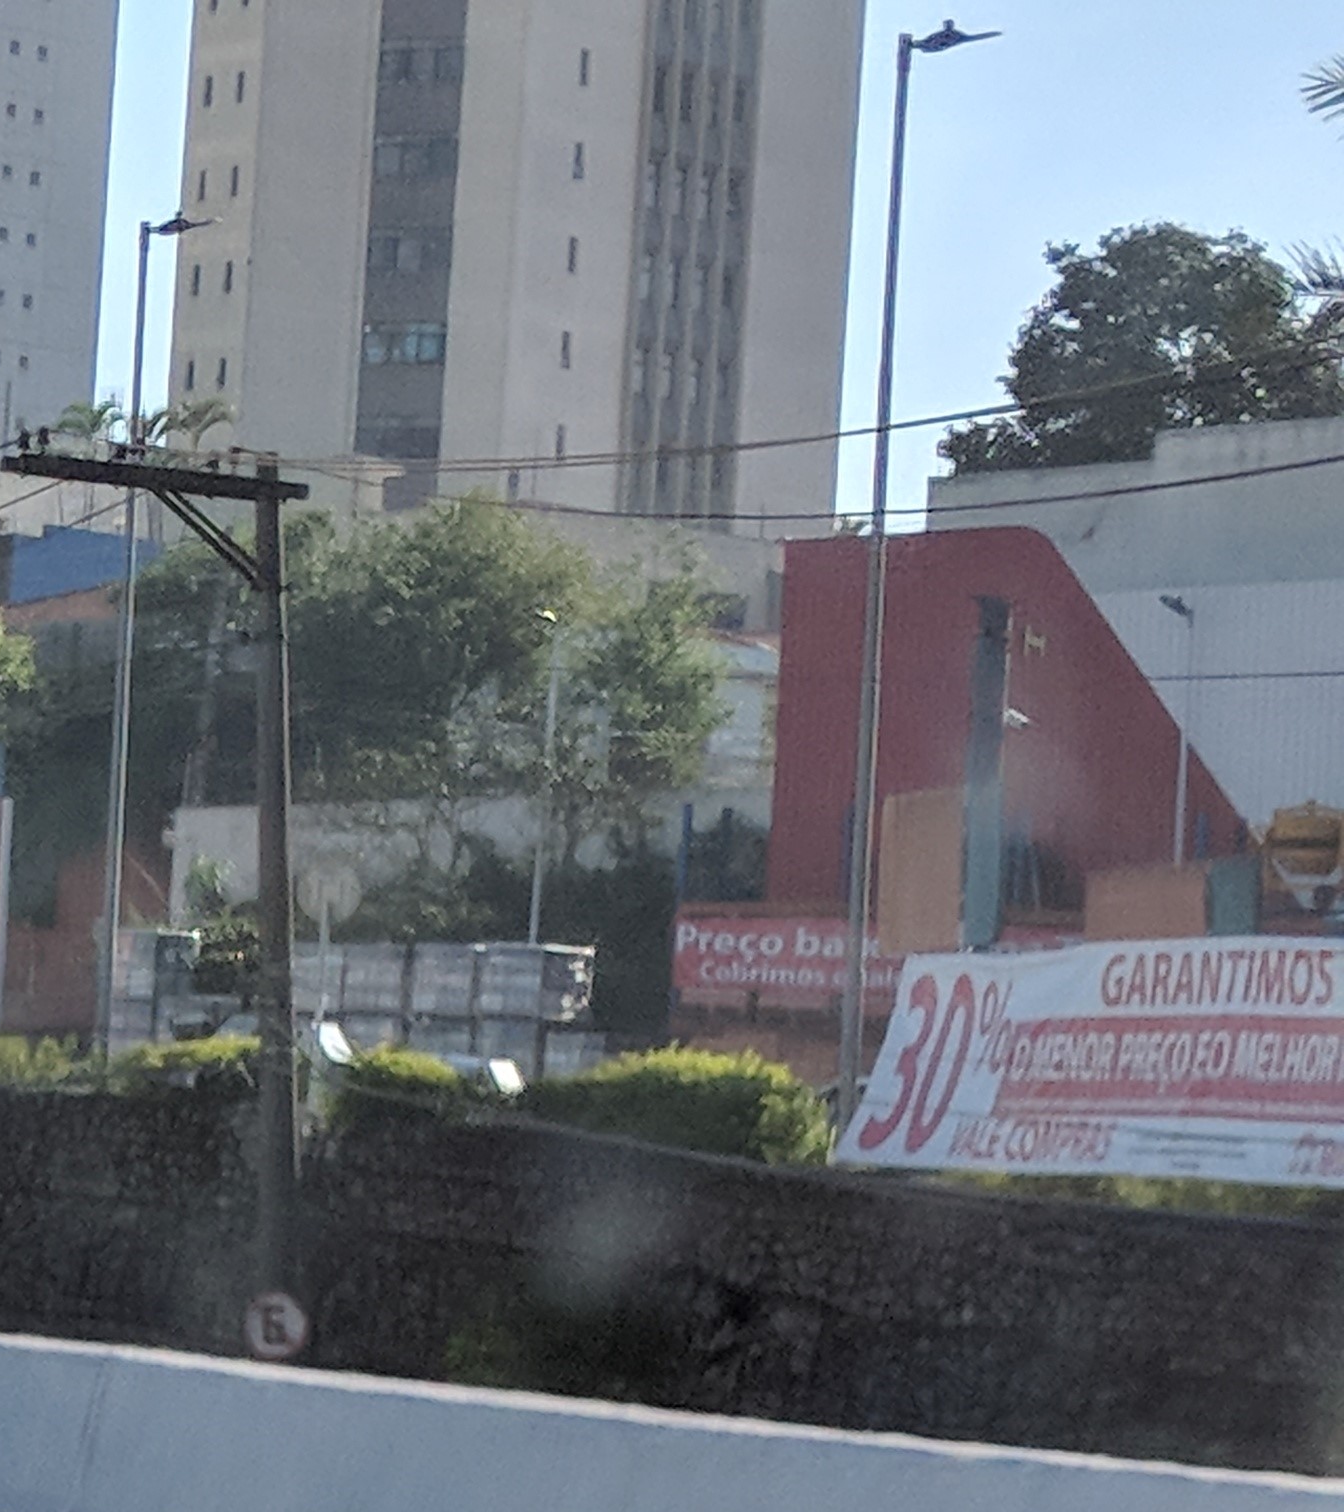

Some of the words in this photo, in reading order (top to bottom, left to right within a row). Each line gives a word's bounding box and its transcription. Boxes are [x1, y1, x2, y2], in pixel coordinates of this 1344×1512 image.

[676, 923, 784, 962] Preço
[1101, 950, 1335, 1007] GARANTIMOS
[1032, 1032, 1116, 1081] MENOR
[1117, 1030, 1192, 1093] PREÇO
[1232, 1030, 1341, 1083] MELHOR
